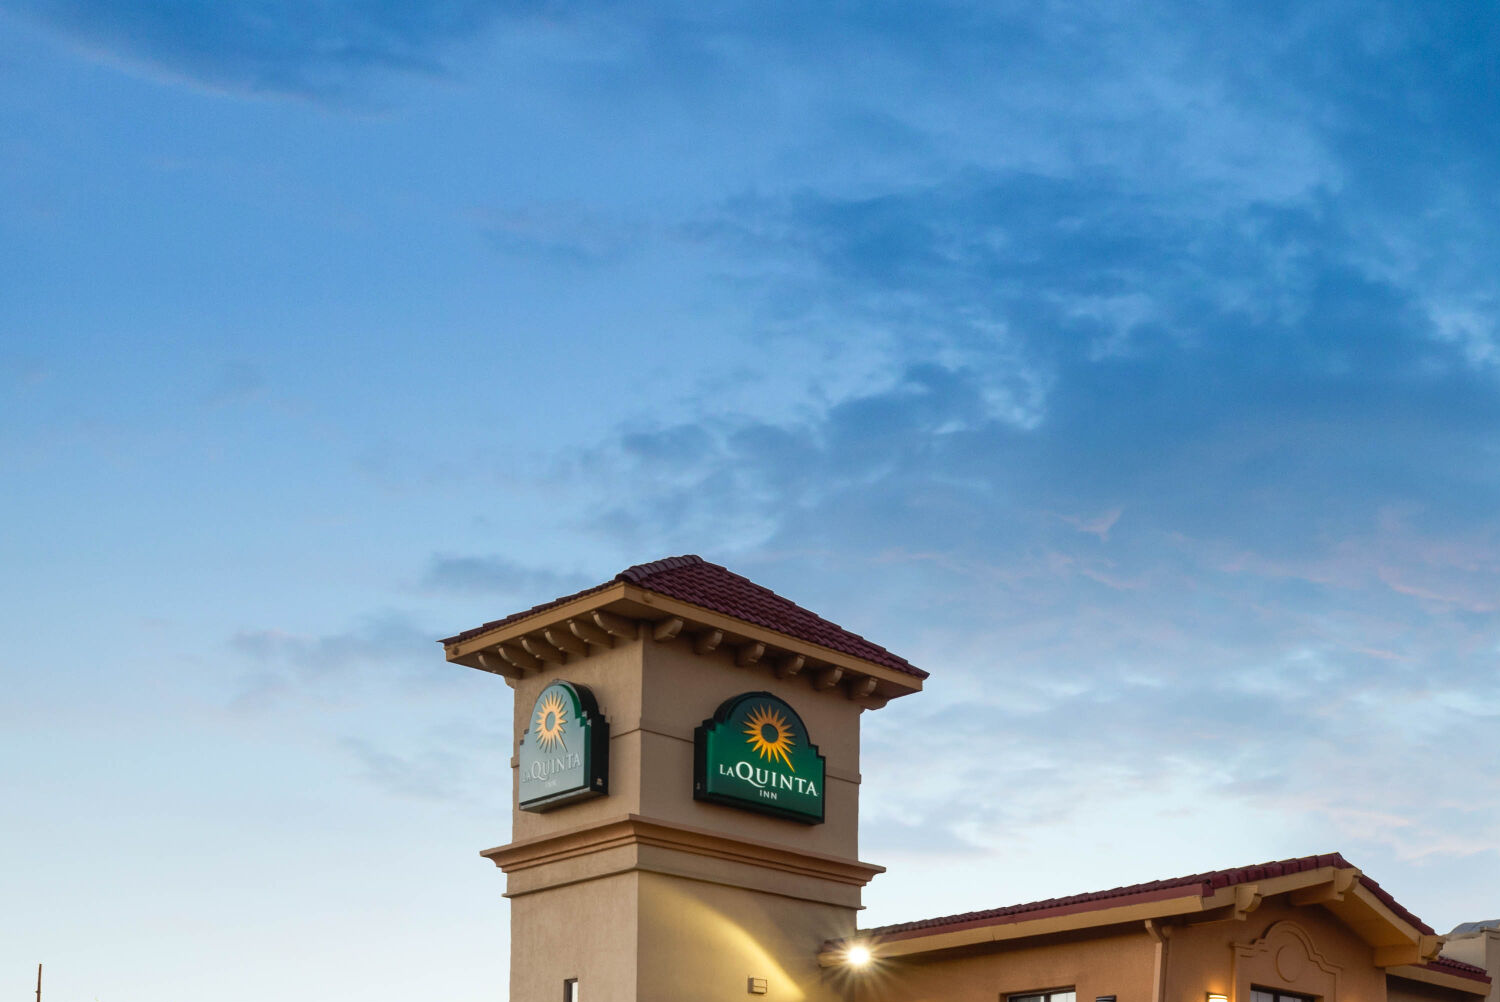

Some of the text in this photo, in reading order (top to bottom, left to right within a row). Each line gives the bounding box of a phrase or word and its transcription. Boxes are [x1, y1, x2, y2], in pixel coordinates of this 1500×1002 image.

[532, 753, 581, 780] QUINTA
[720, 761, 819, 797] LA QUINTA
[759, 790, 777, 800] INN
